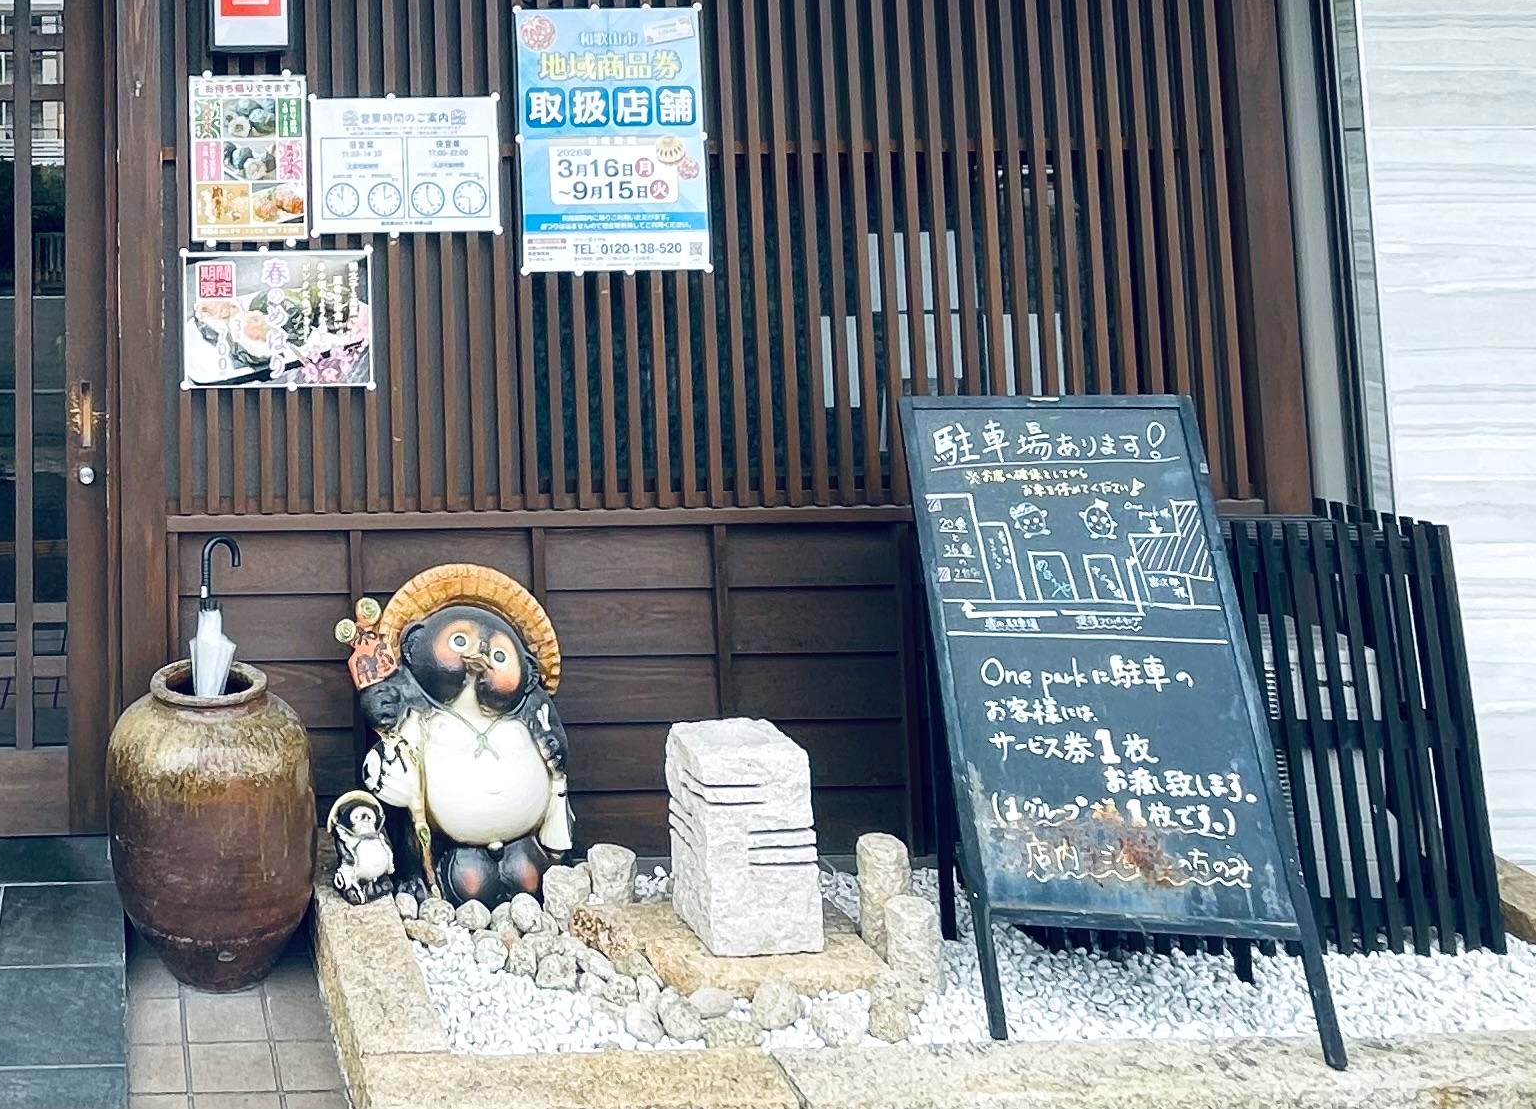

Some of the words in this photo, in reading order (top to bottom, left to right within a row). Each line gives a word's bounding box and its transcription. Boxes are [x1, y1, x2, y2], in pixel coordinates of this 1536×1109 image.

[578, 31, 638, 47] 和歌山市
[538, 50, 682, 81] 地域商品券
[205, 83, 291, 94] お持ち帰りできます
[528, 88, 694, 125] 取扱店舗
[360, 112, 449, 124] 営業時間のご案内
[557, 148, 592, 157] 2026年
[263, 258, 290, 379] 春のめはり
